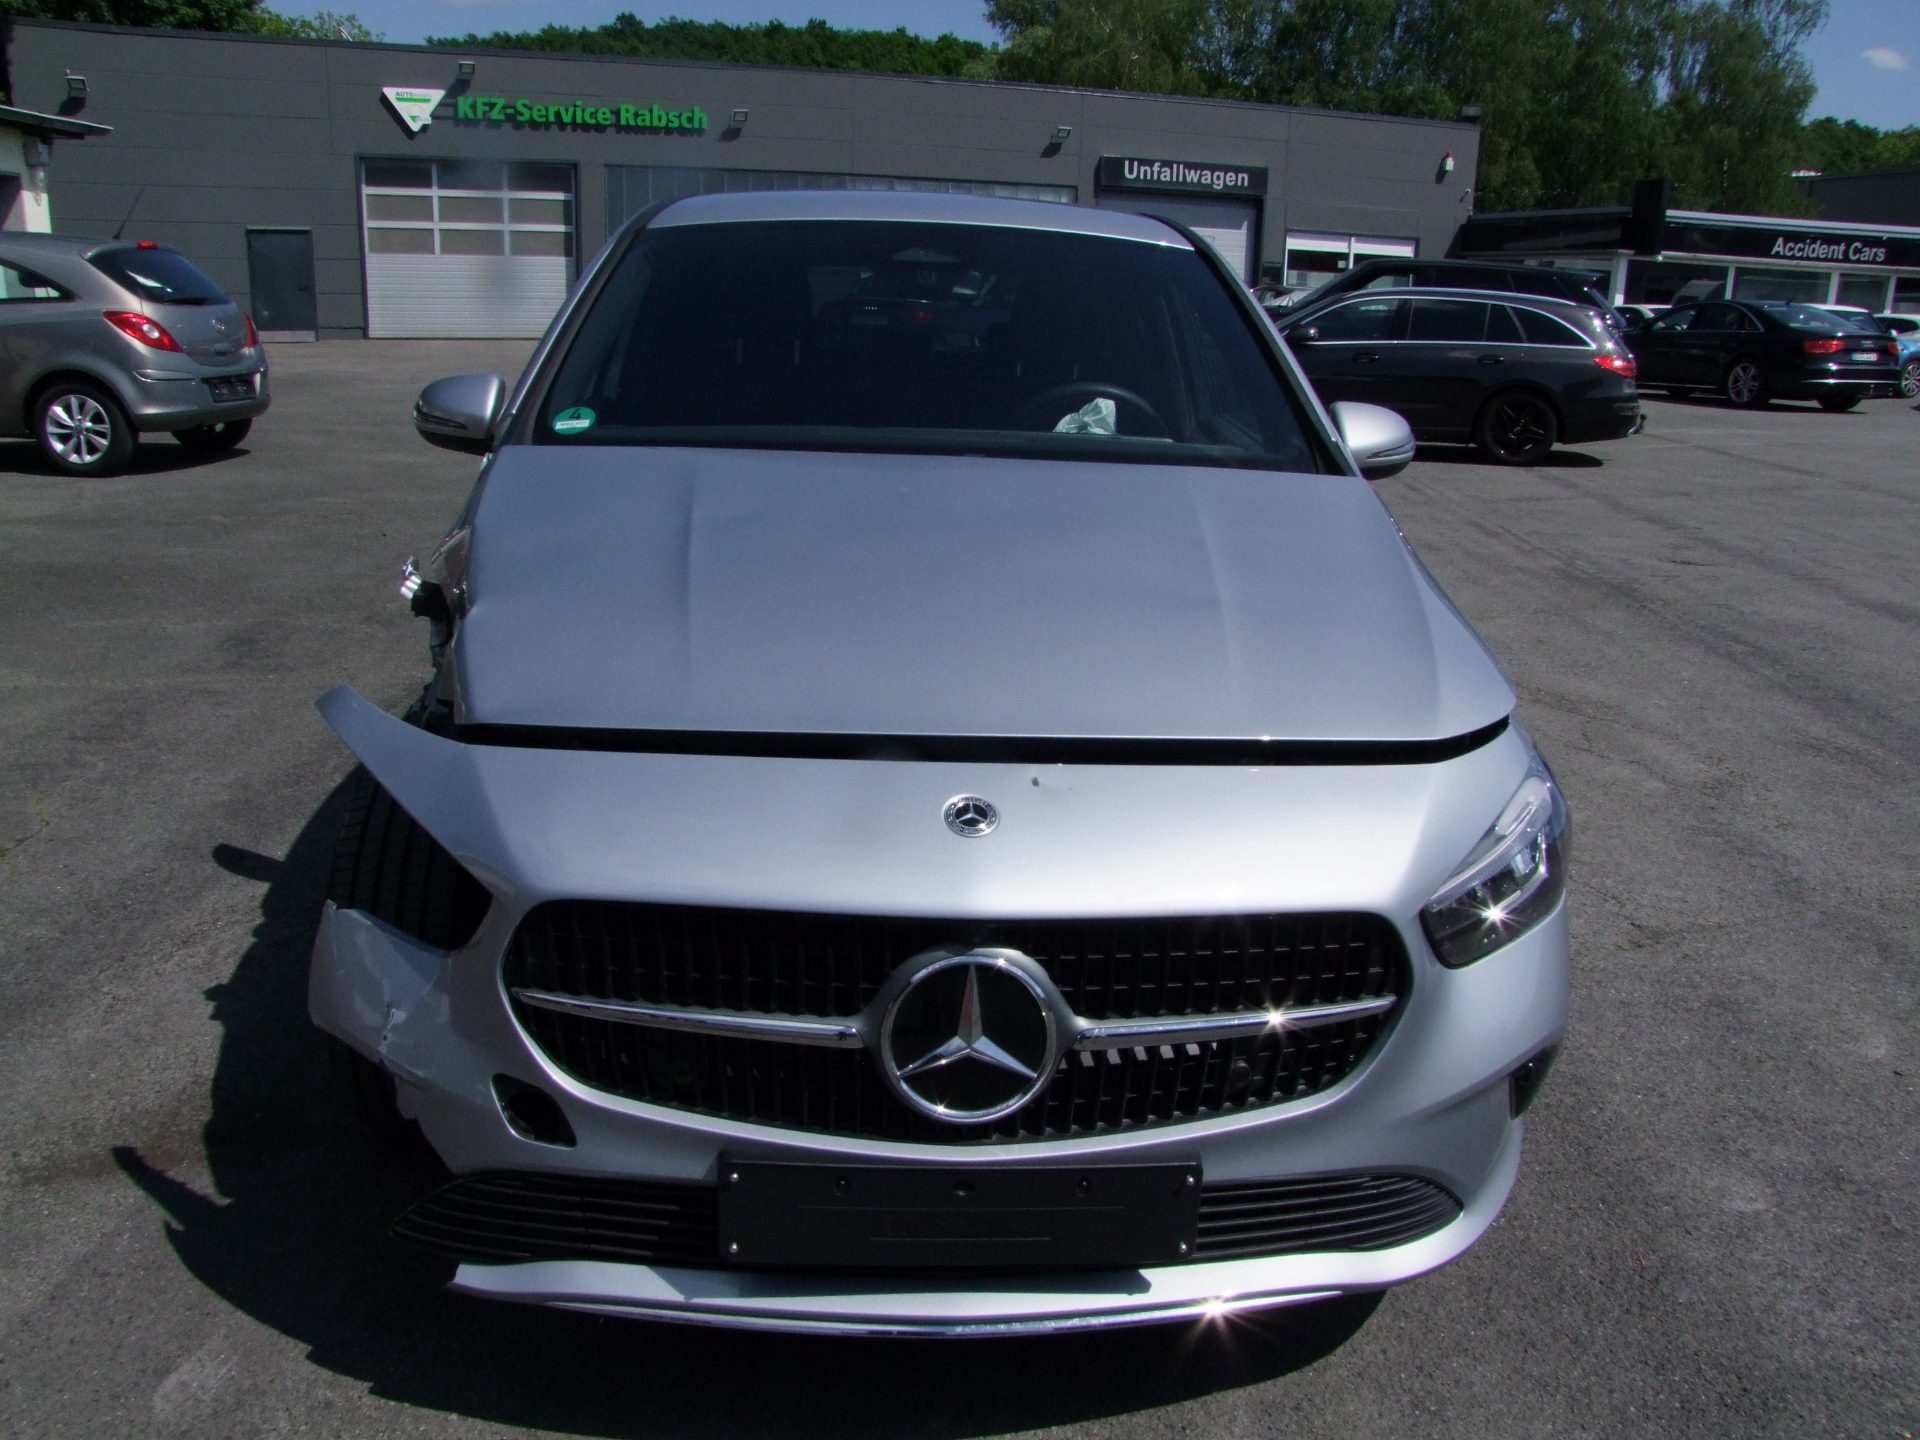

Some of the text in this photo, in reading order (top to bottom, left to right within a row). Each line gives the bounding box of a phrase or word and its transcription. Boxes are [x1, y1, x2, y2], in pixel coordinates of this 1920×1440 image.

[457, 96, 708, 129] KFZ-Service Rabsch
[1124, 160, 1249, 189] Unfallwagen
[1771, 237, 1886, 262] Accident Cars
[569, 407, 582, 420] 4
